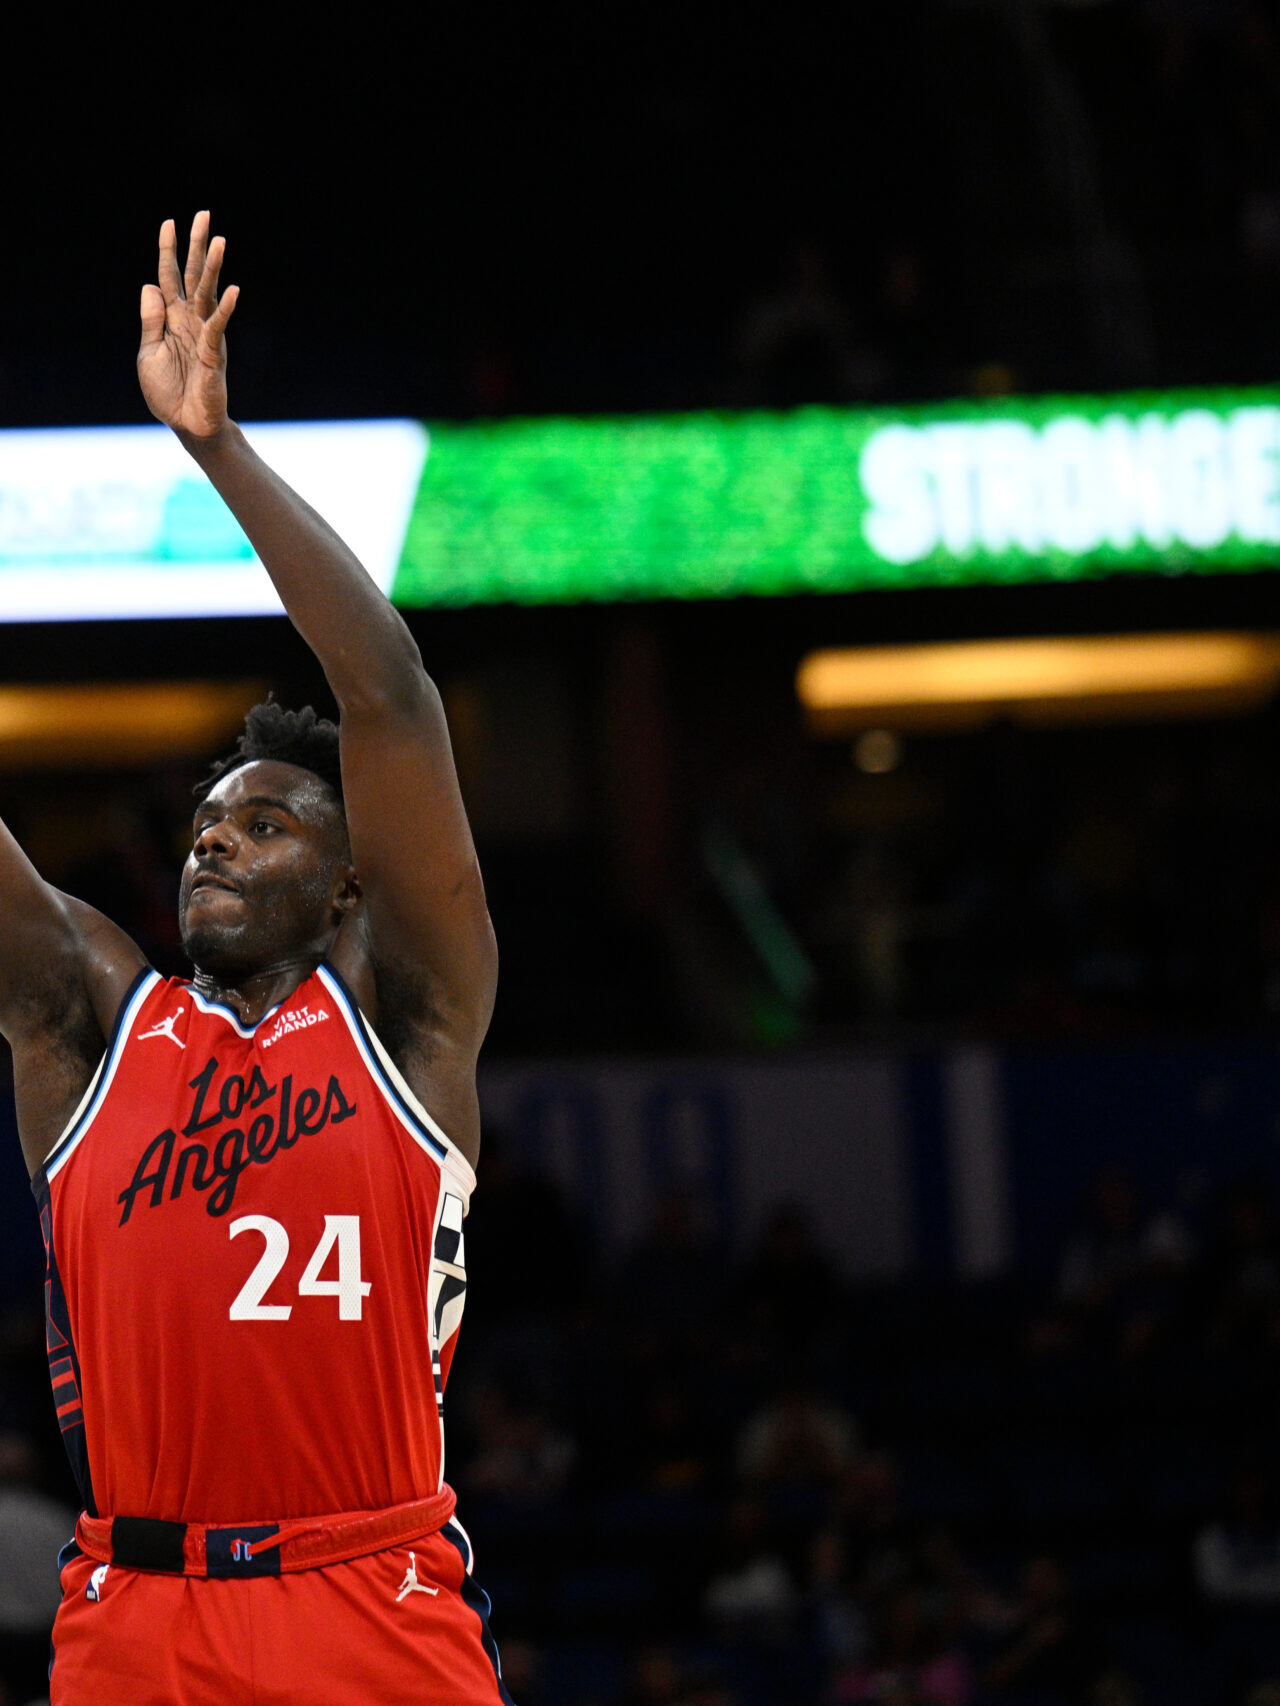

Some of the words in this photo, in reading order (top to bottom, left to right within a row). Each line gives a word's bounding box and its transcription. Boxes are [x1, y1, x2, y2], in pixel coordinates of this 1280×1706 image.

[262, 1010, 329, 1048] RWANDA
[274, 1006, 308, 1029] VISIT
[182, 1057, 277, 1138] Los
[117, 1074, 357, 1228] Angeles
[228, 1214, 372, 1321] 24
